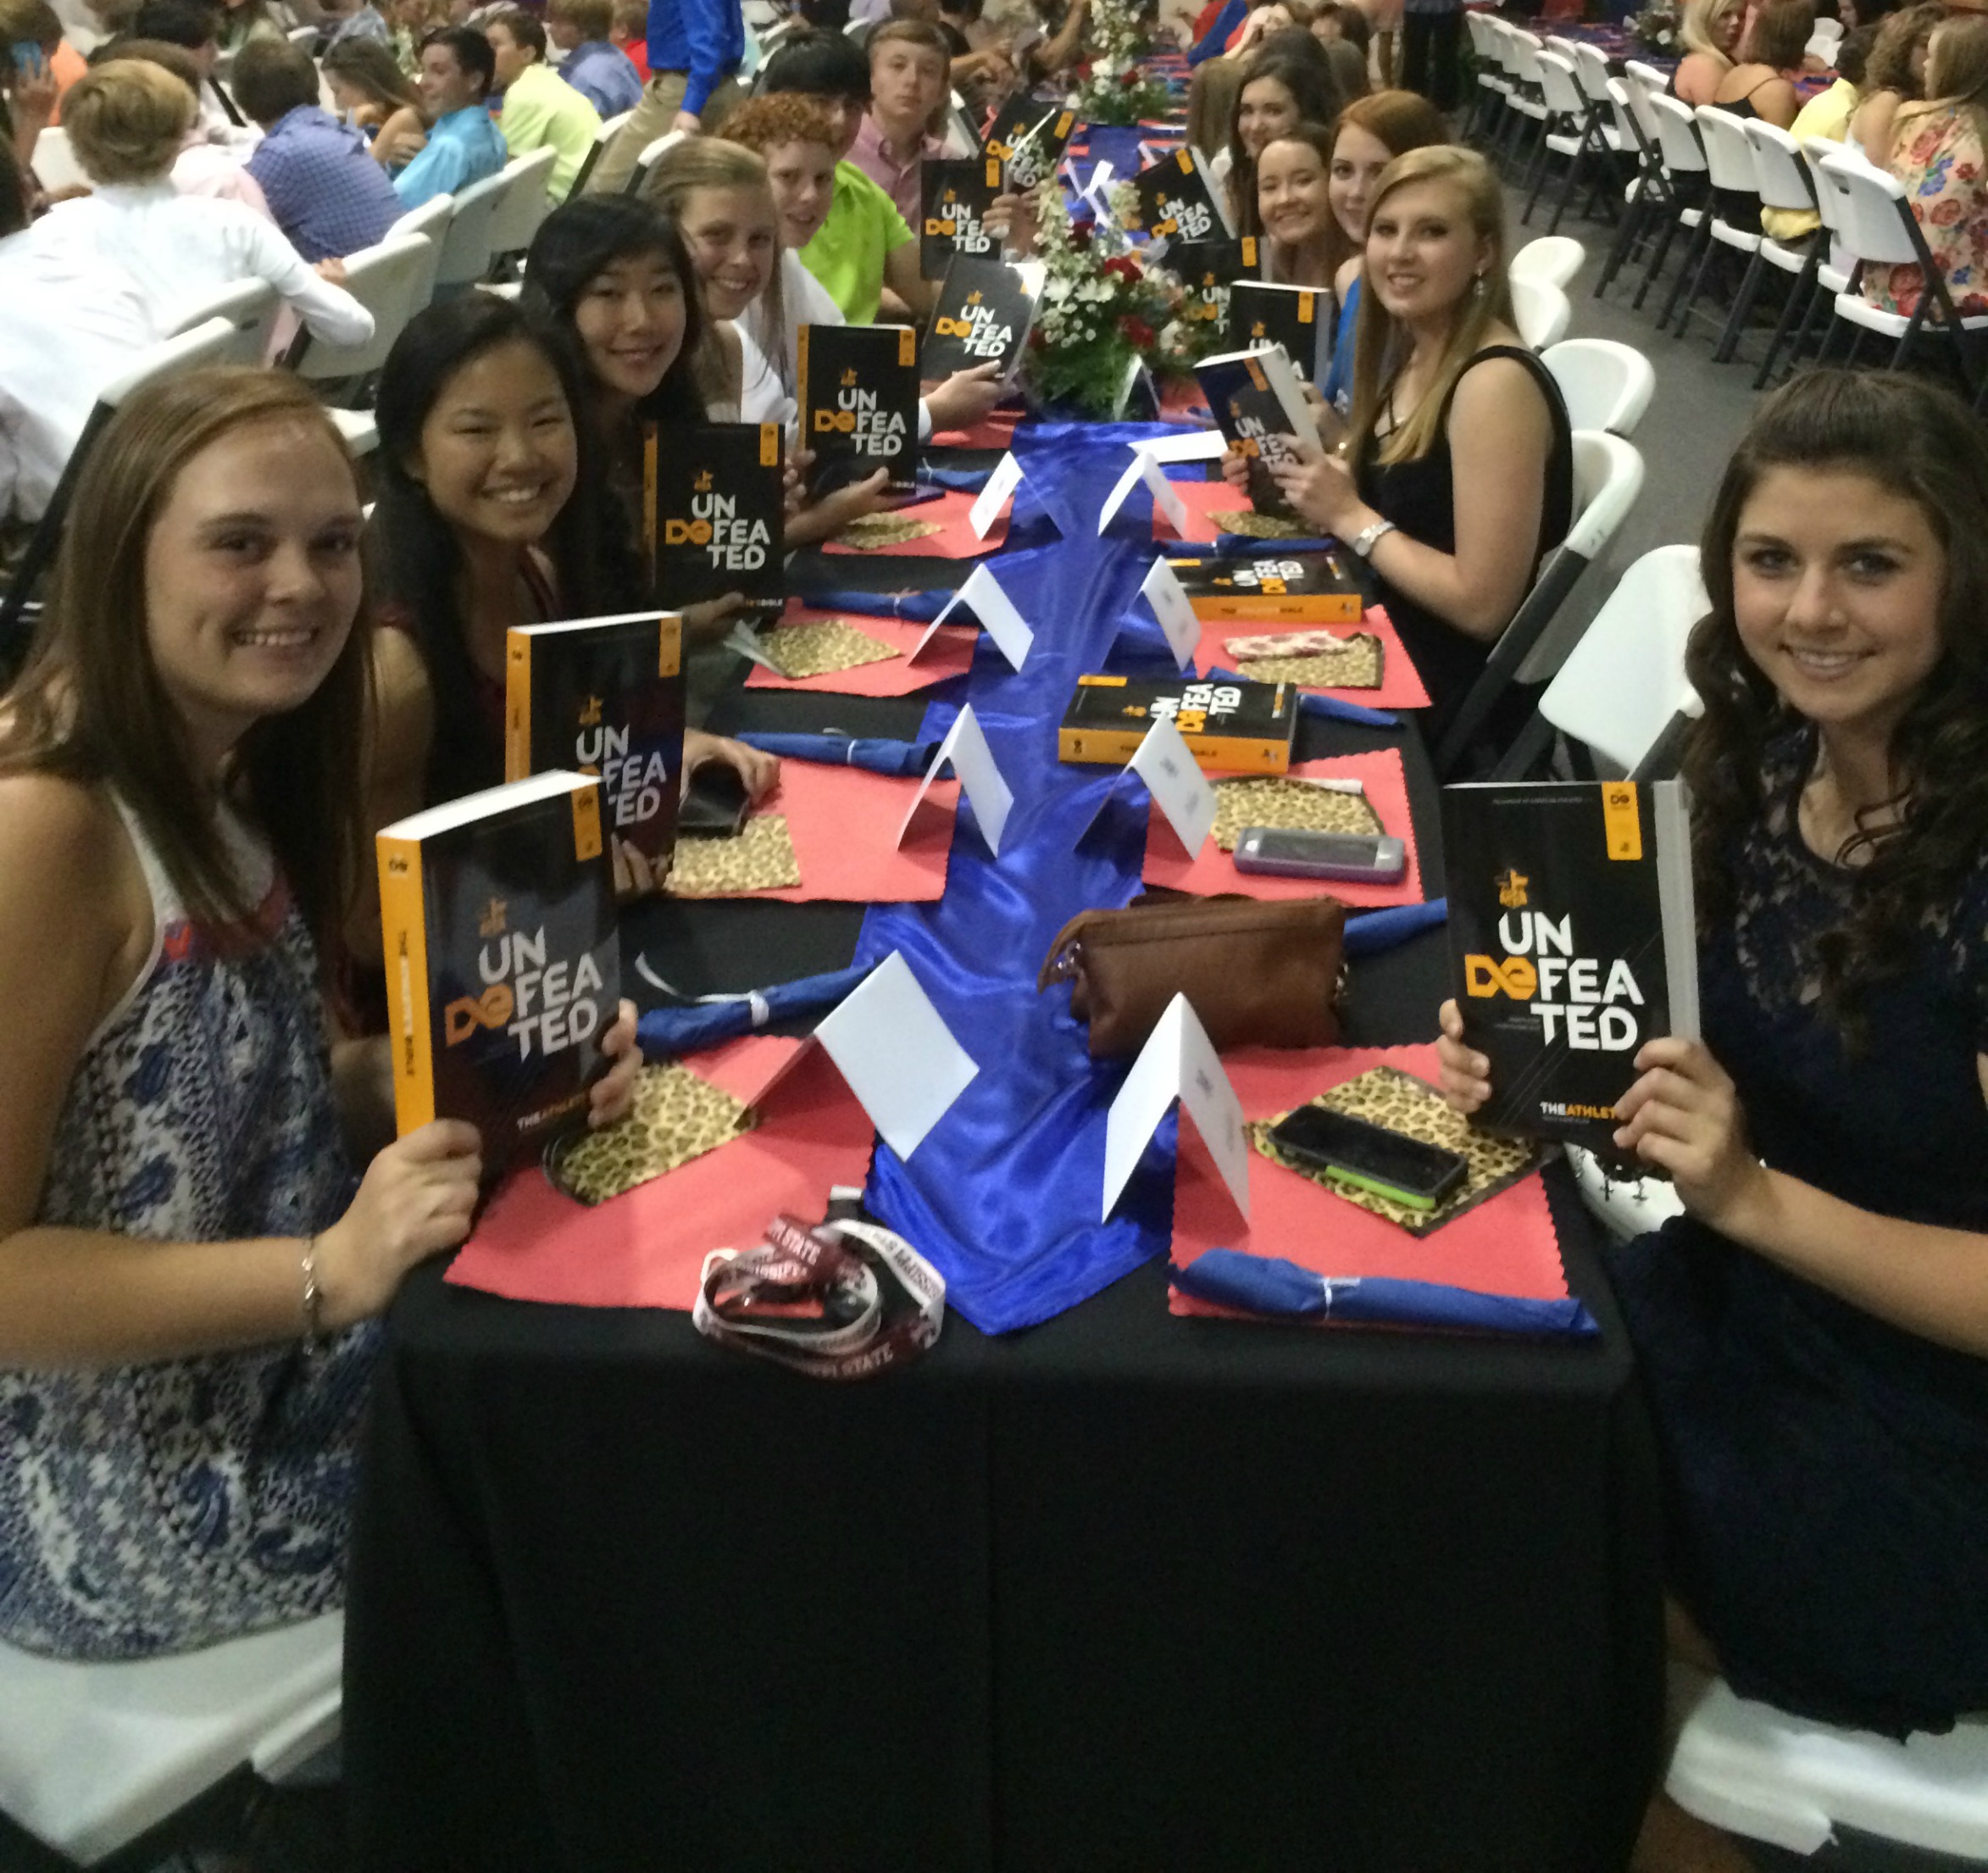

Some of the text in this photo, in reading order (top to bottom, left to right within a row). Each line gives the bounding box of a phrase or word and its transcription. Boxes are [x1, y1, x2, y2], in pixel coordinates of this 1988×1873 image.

[941, 203, 972, 220] UN
[1159, 197, 1185, 220] UN
[1177, 216, 1212, 241] TED
[952, 236, 991, 253] TED
[960, 305, 995, 324] UN
[963, 339, 1005, 357] TED
[838, 388, 876, 411] UN
[1235, 416, 1265, 438] UN
[850, 433, 902, 456] TED
[691, 493, 736, 519] UN
[706, 544, 766, 570] TED
[1209, 686, 1242, 715] TED
[576, 724, 630, 764] UN
[608, 786, 660, 826] ED
[1498, 911, 1574, 956] UN
[479, 925, 547, 984] UN
[508, 997, 598, 1064] TED
[1530, 1003, 1639, 1052] TED
